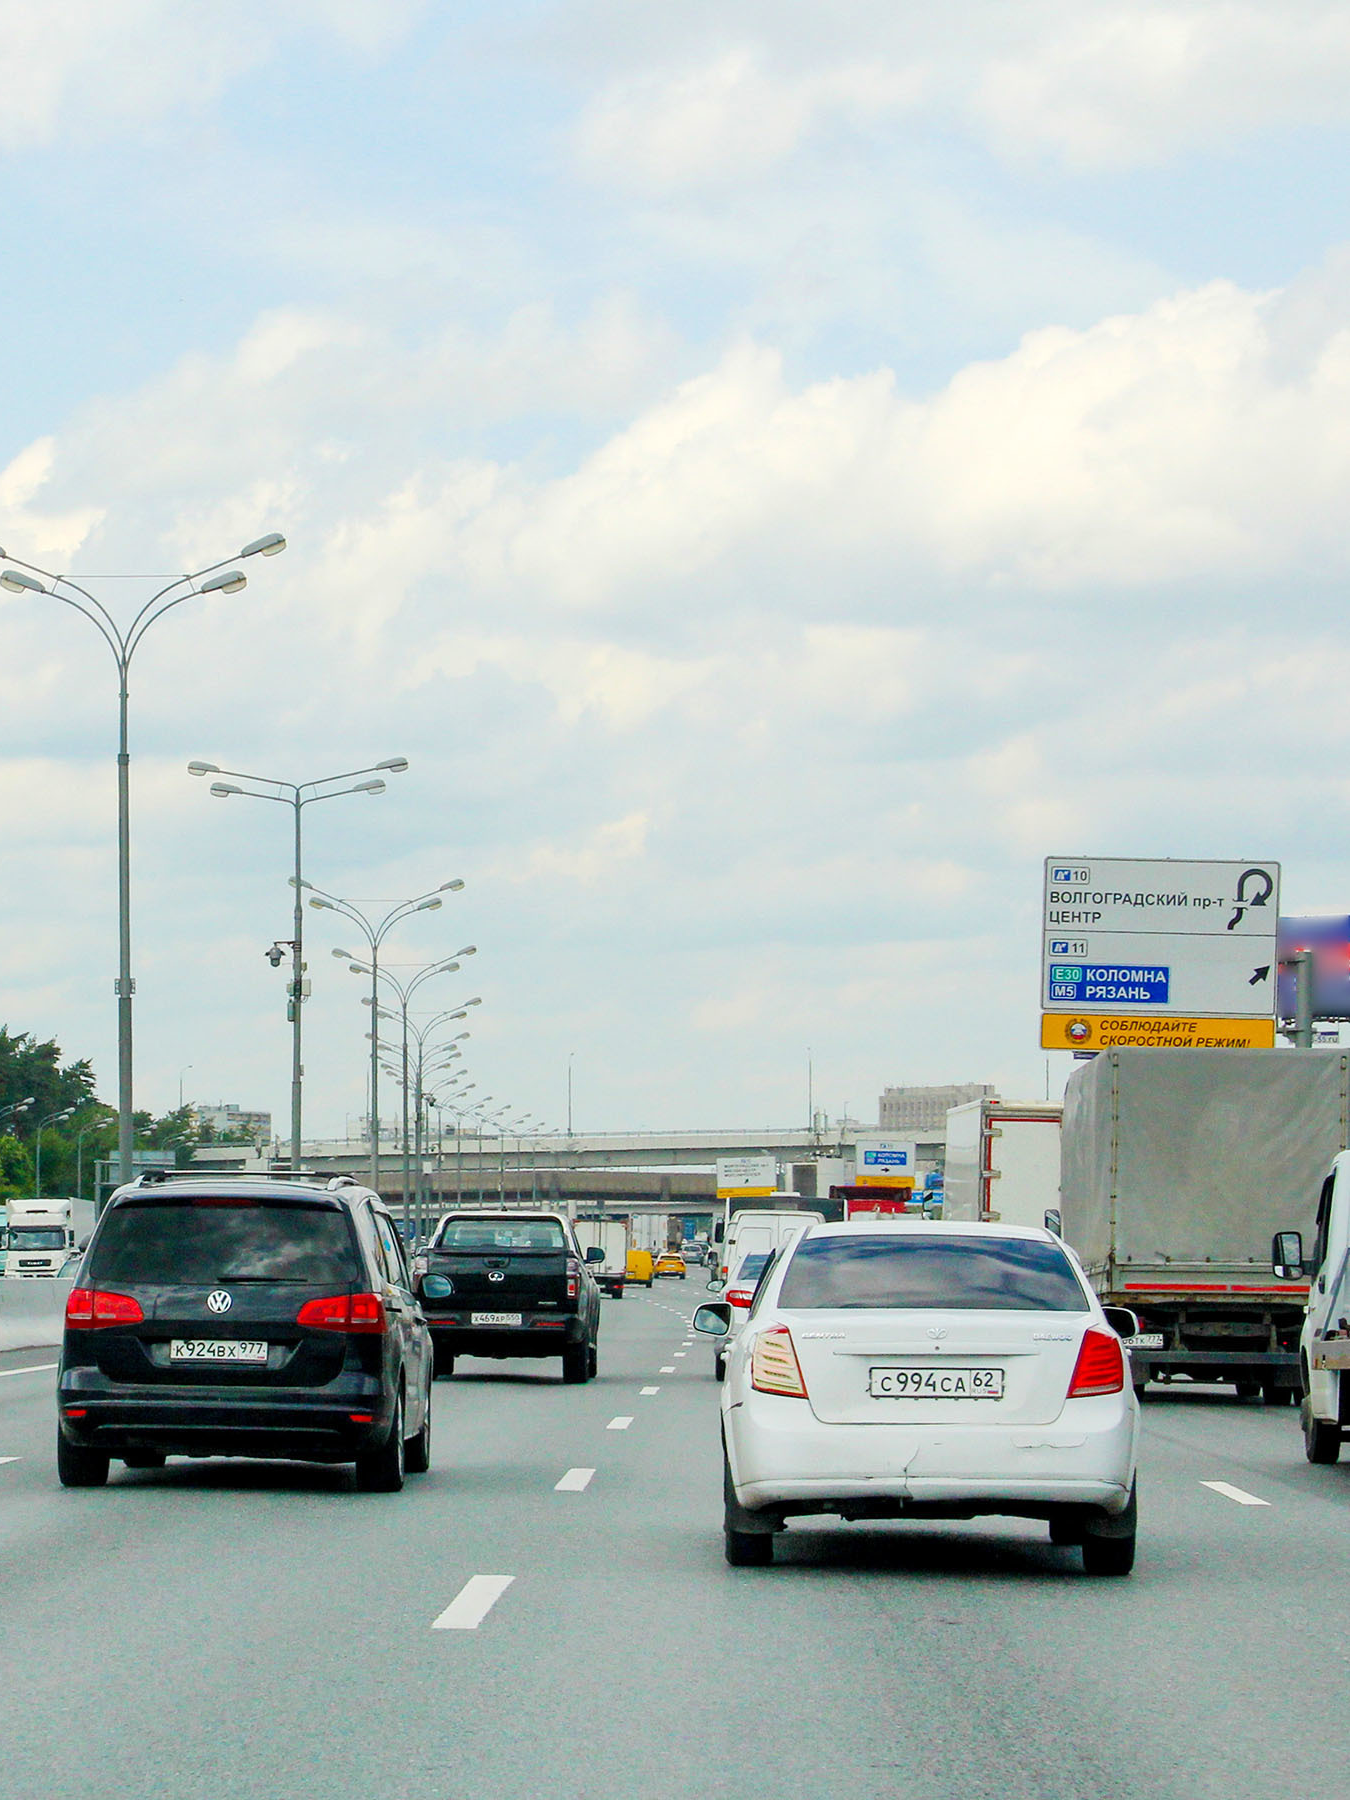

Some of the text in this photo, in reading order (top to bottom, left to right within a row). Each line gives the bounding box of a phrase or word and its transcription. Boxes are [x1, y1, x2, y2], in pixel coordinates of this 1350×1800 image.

[1073, 871, 1087, 881] 10
[1050, 891, 1224, 909] ВОЛГОГРАДСКИЙ пр-т
[1049, 911, 1101, 924] ЦЕНТР
[1072, 943, 1084, 954] 11
[1055, 969, 1166, 983] E30 КОЛОМНА
[1085, 986, 1151, 1000] РЯЗАНЬ
[1100, 1019, 1198, 1034] СОБЛЮДАЙТЕ
[1100, 1035, 1193, 1048] СКОРОСТНОЙ
